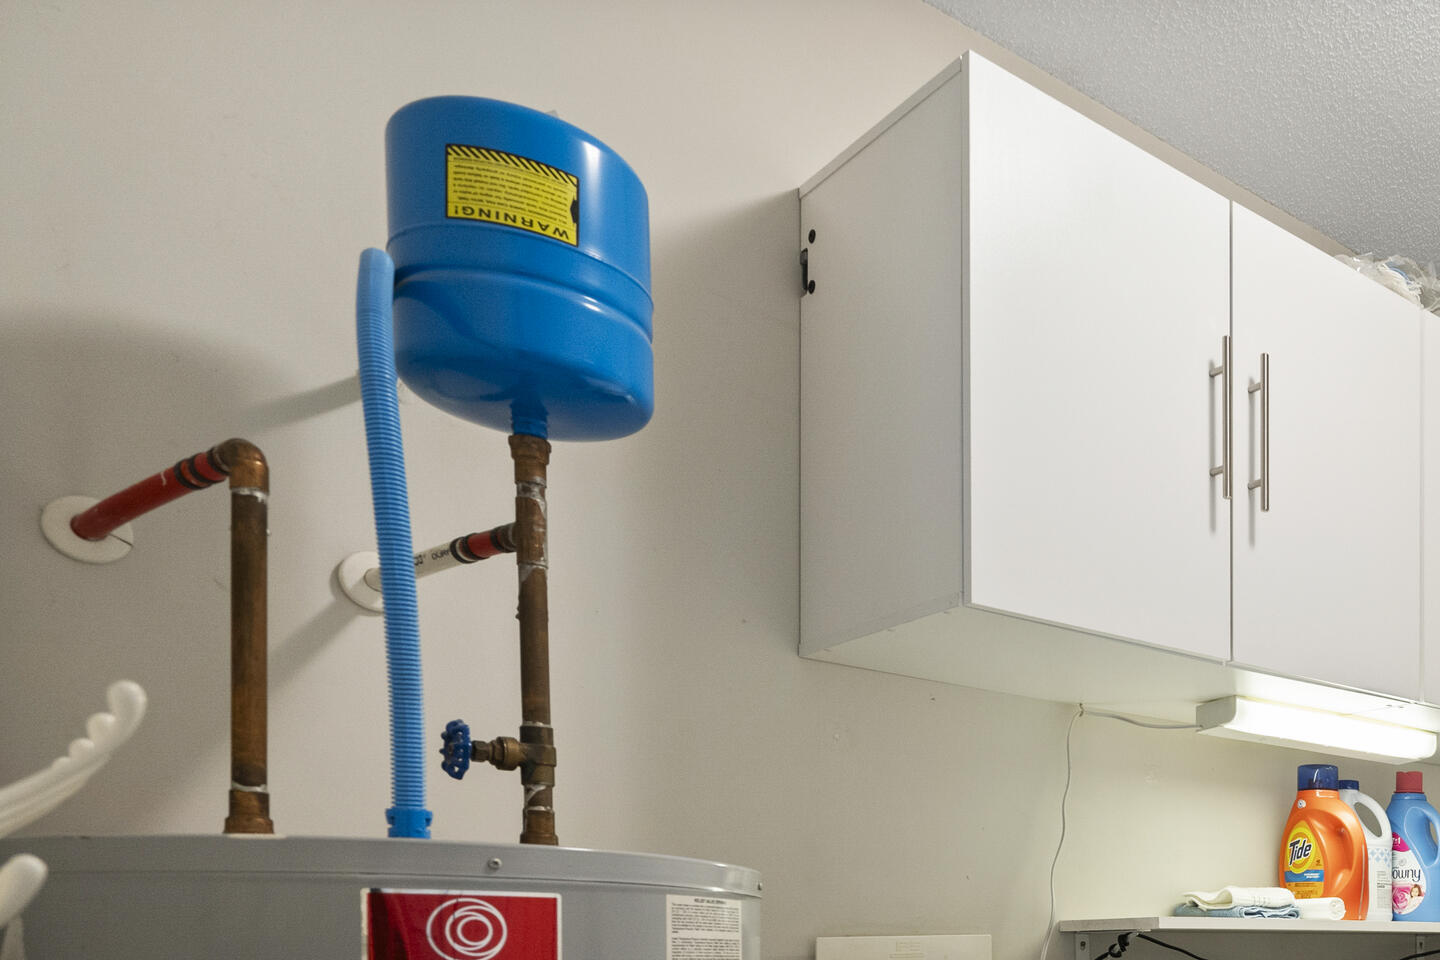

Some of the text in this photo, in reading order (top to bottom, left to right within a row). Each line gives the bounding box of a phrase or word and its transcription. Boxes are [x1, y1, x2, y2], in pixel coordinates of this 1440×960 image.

[454, 205, 570, 240] WARNING!
[1288, 838, 1312, 866] Tide
[1392, 868, 1421, 882] owny
